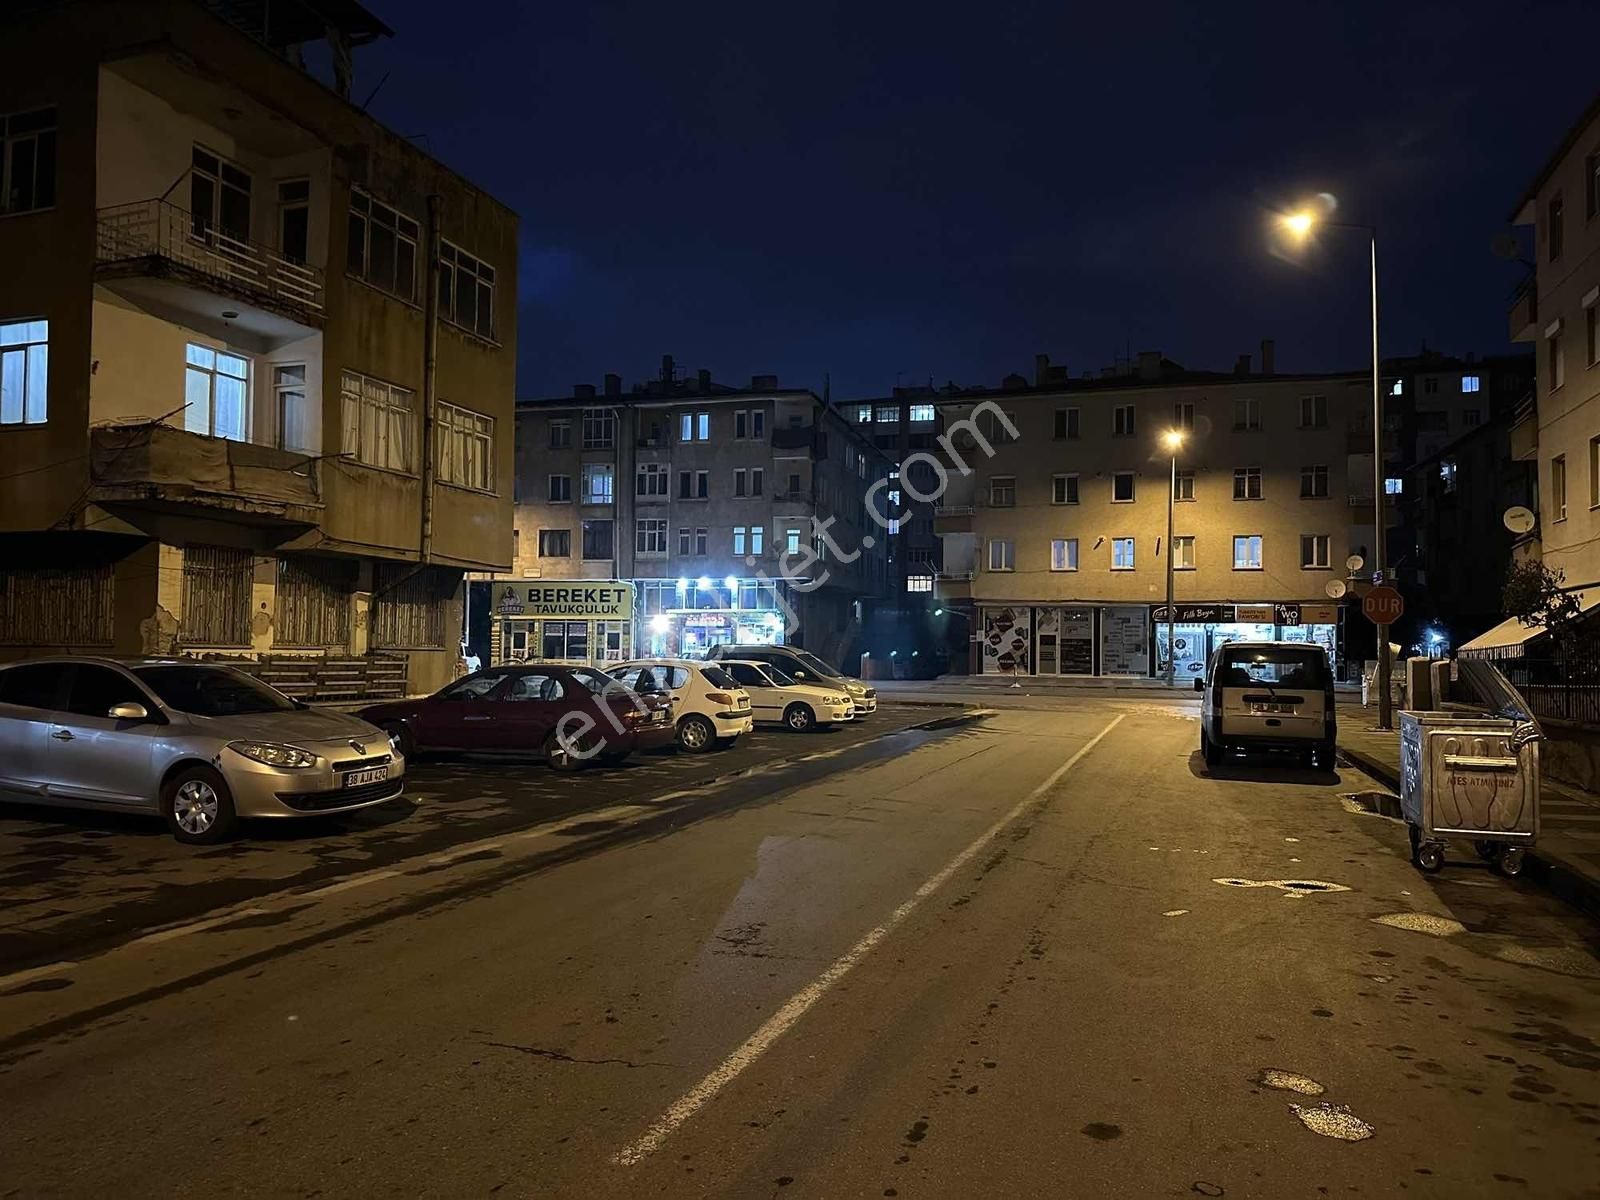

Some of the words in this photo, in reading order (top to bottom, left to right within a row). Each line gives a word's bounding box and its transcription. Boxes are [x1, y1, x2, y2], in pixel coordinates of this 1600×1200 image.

[528, 588, 626, 603] BEREKET
[534, 604, 619, 616] TAVUKÇULUK
[1366, 597, 1401, 613] DUR
